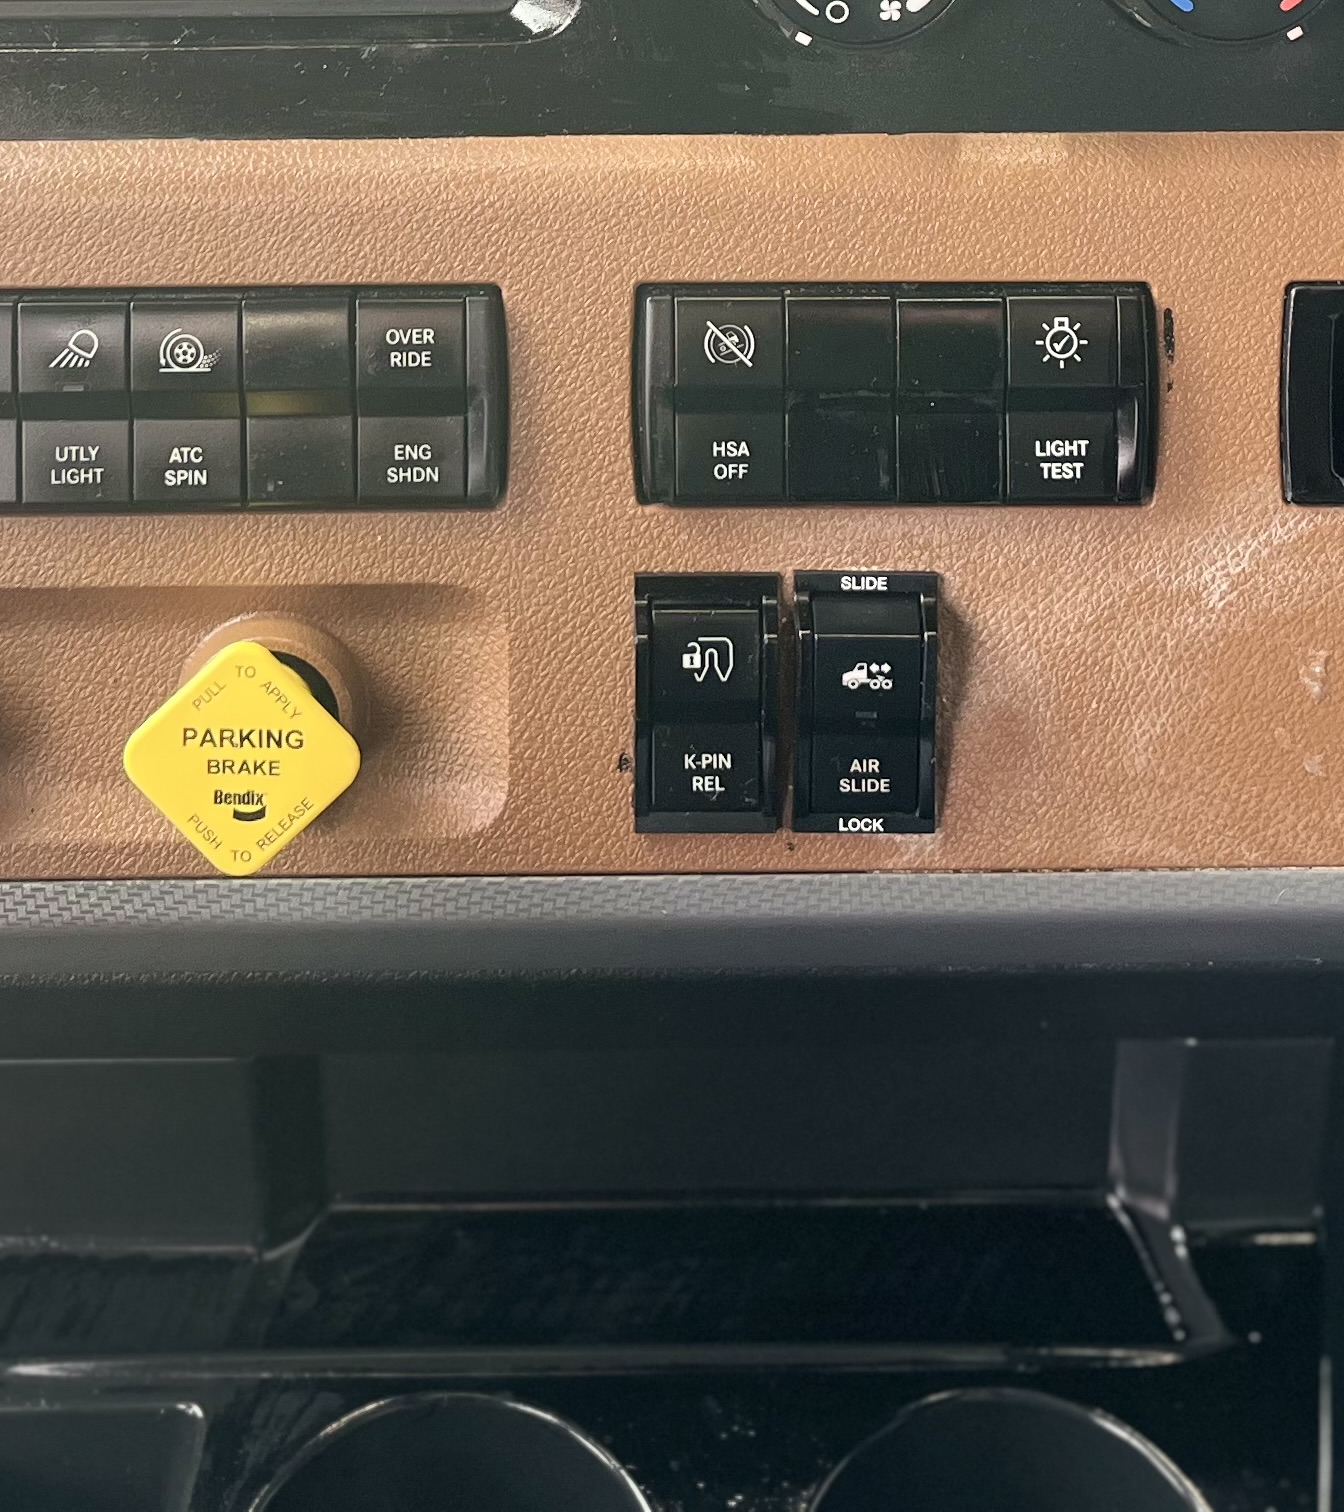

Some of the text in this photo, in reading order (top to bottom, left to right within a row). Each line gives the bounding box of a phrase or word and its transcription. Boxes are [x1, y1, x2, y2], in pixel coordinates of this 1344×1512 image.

[385, 328, 435, 345] OVER
[390, 350, 432, 368] RIDE
[55, 445, 100, 462] UTLY
[168, 446, 203, 464] ATC
[394, 444, 432, 461] ENG
[712, 440, 750, 457] HSA
[1035, 439, 1090, 457] LIGHT
[50, 467, 105, 485] LIGHT
[164, 469, 207, 487] SPIN
[386, 466, 439, 483] SHDN
[713, 463, 749, 480] OFF
[1039, 462, 1085, 480] TEST
[840, 575, 888, 591] SLIDE
[191, 665, 304, 720] PULL TO APPLY
[182, 727, 304, 750] PARKING
[207, 759, 280, 776] BRAKE
[684, 753, 732, 770] K-PIN
[849, 758, 880, 773] AIR
[692, 775, 726, 792] REL
[839, 778, 891, 793] SLIDE
[213, 789, 264, 807] Bendix
[185, 796, 315, 863] PUSH TO RELEASE
[838, 817, 884, 833] LOCK
